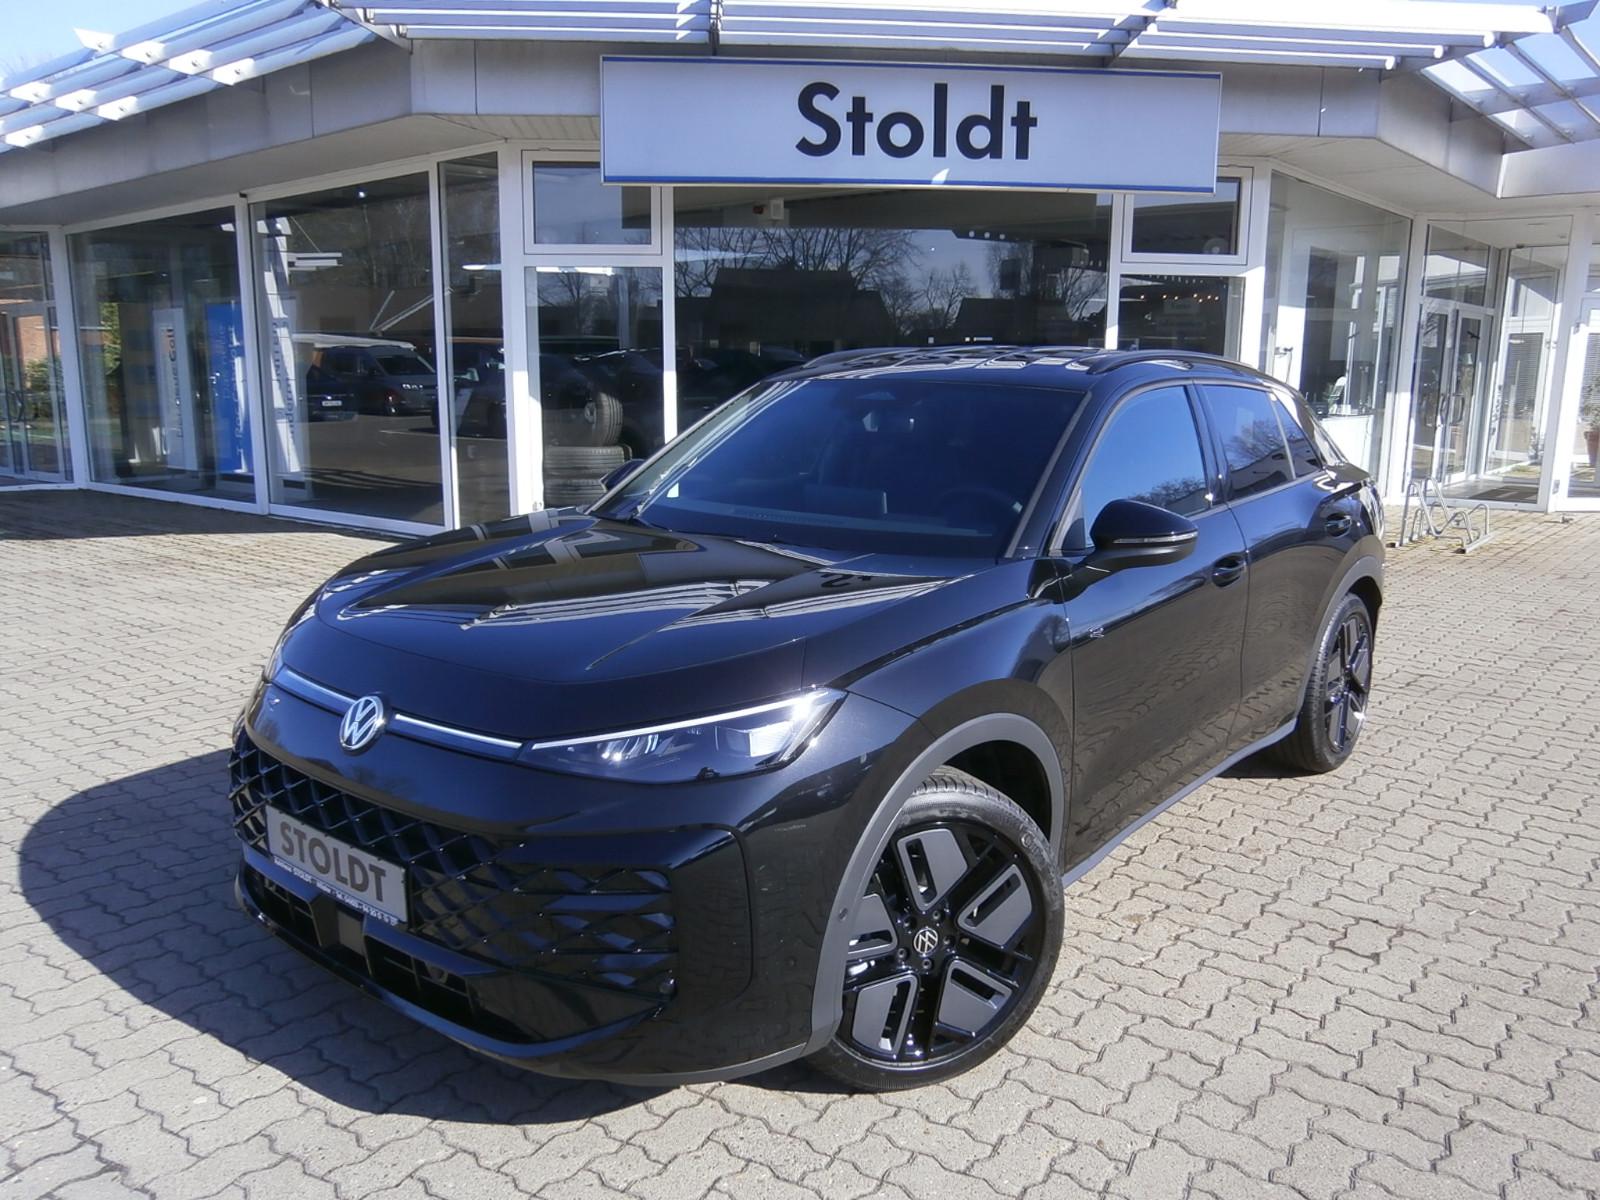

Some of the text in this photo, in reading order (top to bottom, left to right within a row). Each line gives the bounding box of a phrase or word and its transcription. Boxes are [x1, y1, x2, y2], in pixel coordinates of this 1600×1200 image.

[795, 81, 1038, 160] Stoldt
[165, 328, 177, 362] Golf
[279, 821, 386, 902] STOLDT
